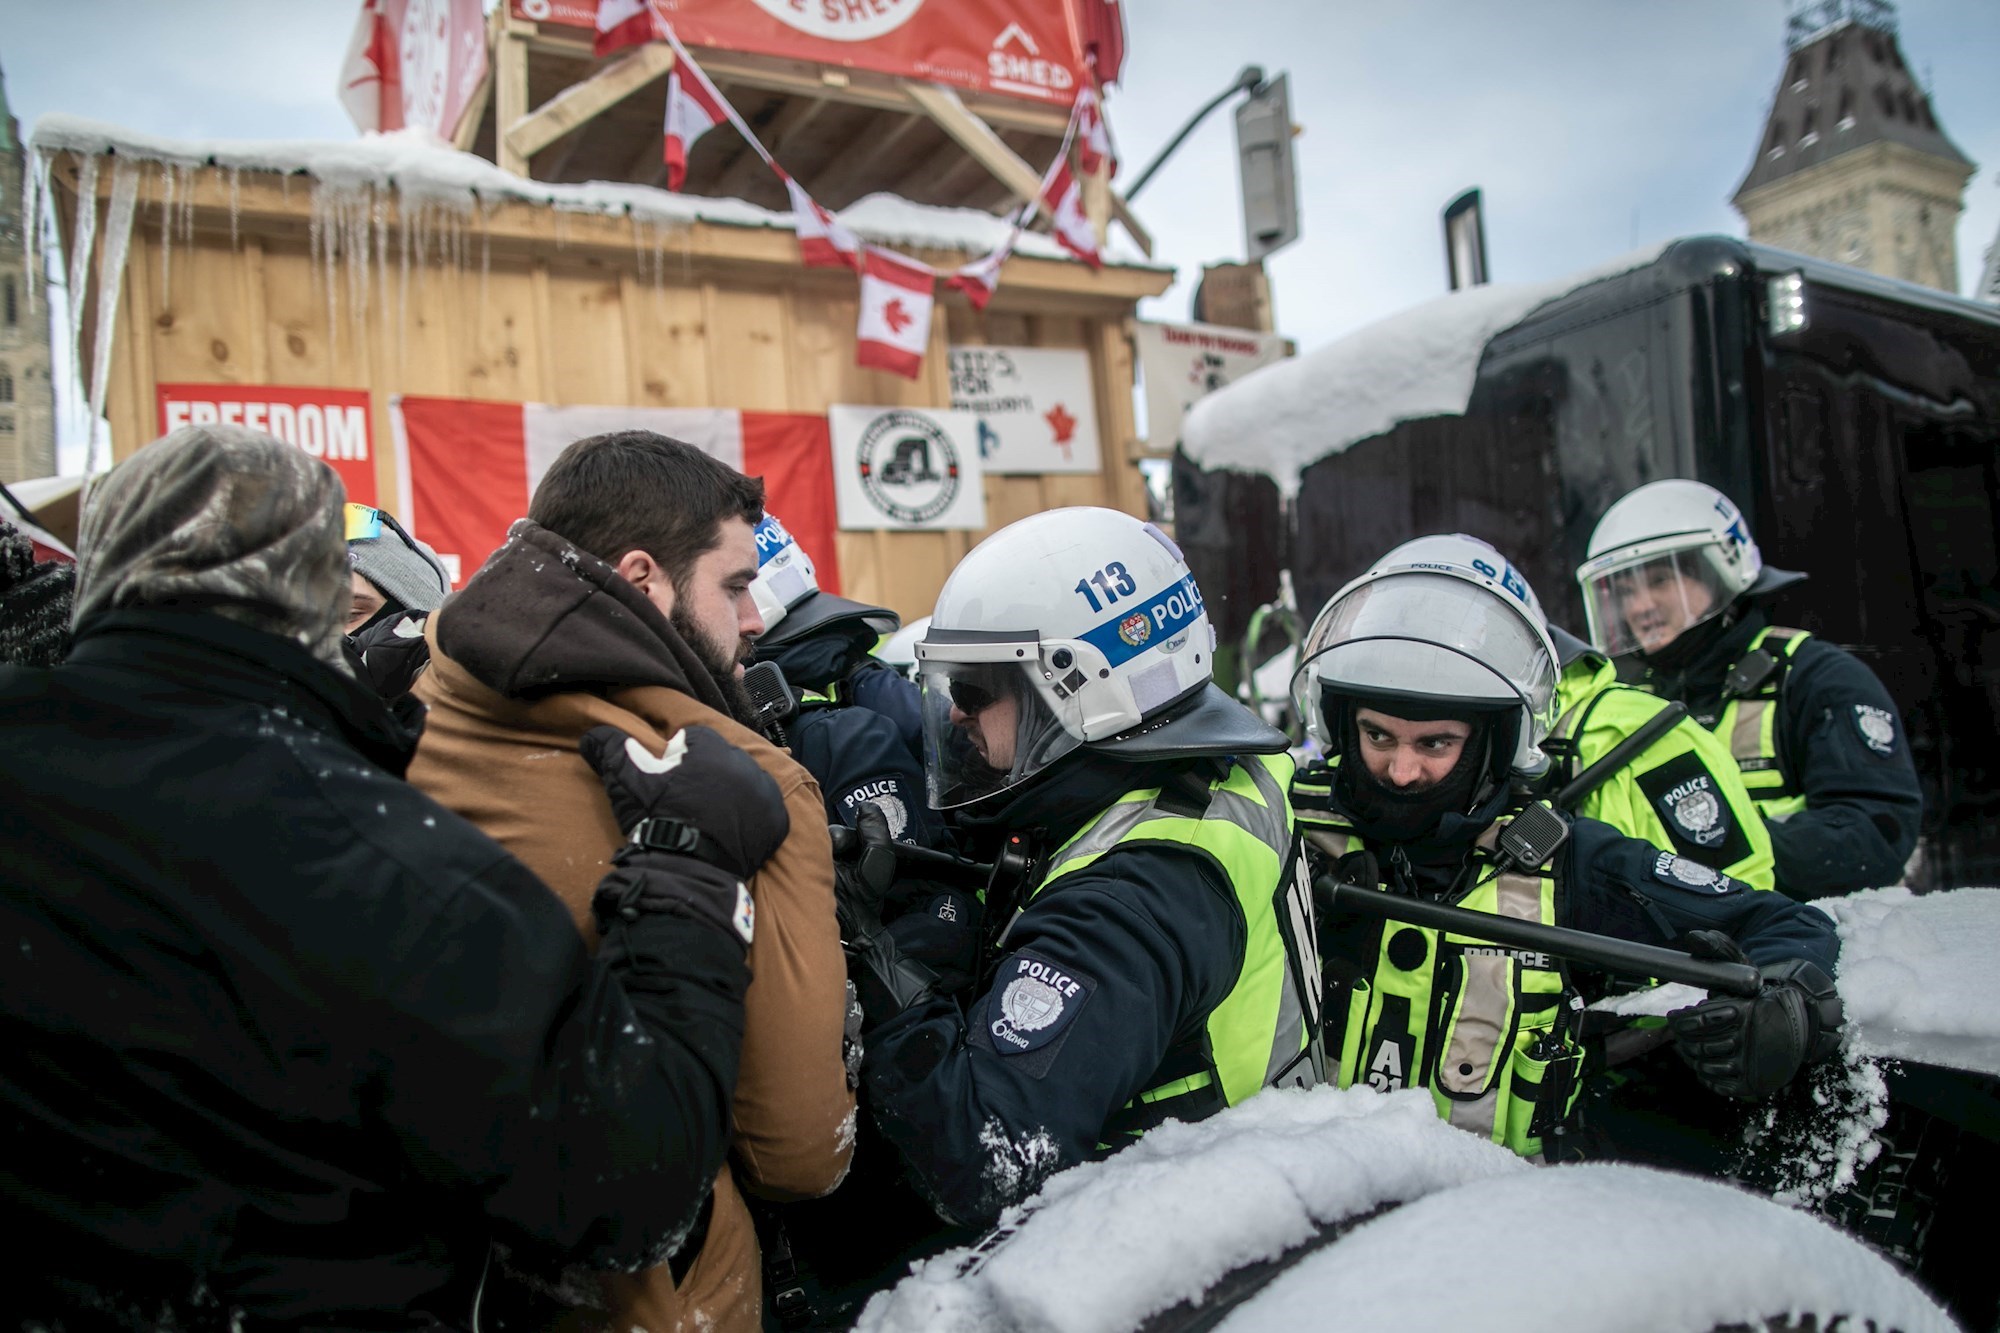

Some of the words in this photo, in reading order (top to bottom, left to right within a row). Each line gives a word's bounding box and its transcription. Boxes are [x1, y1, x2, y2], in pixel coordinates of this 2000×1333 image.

[988, 51, 1073, 89] SHED
[1411, 563, 1453, 571] POLICE
[1074, 561, 1136, 614] 113
[1151, 580, 1203, 630] POLIC
[843, 780, 898, 808] POLICE
[1663, 775, 1709, 807] POLICE
[1017, 959, 1080, 999] POLICE
[991, 1018, 1030, 1049] Ottawa
[1370, 1038, 1403, 1078] A
